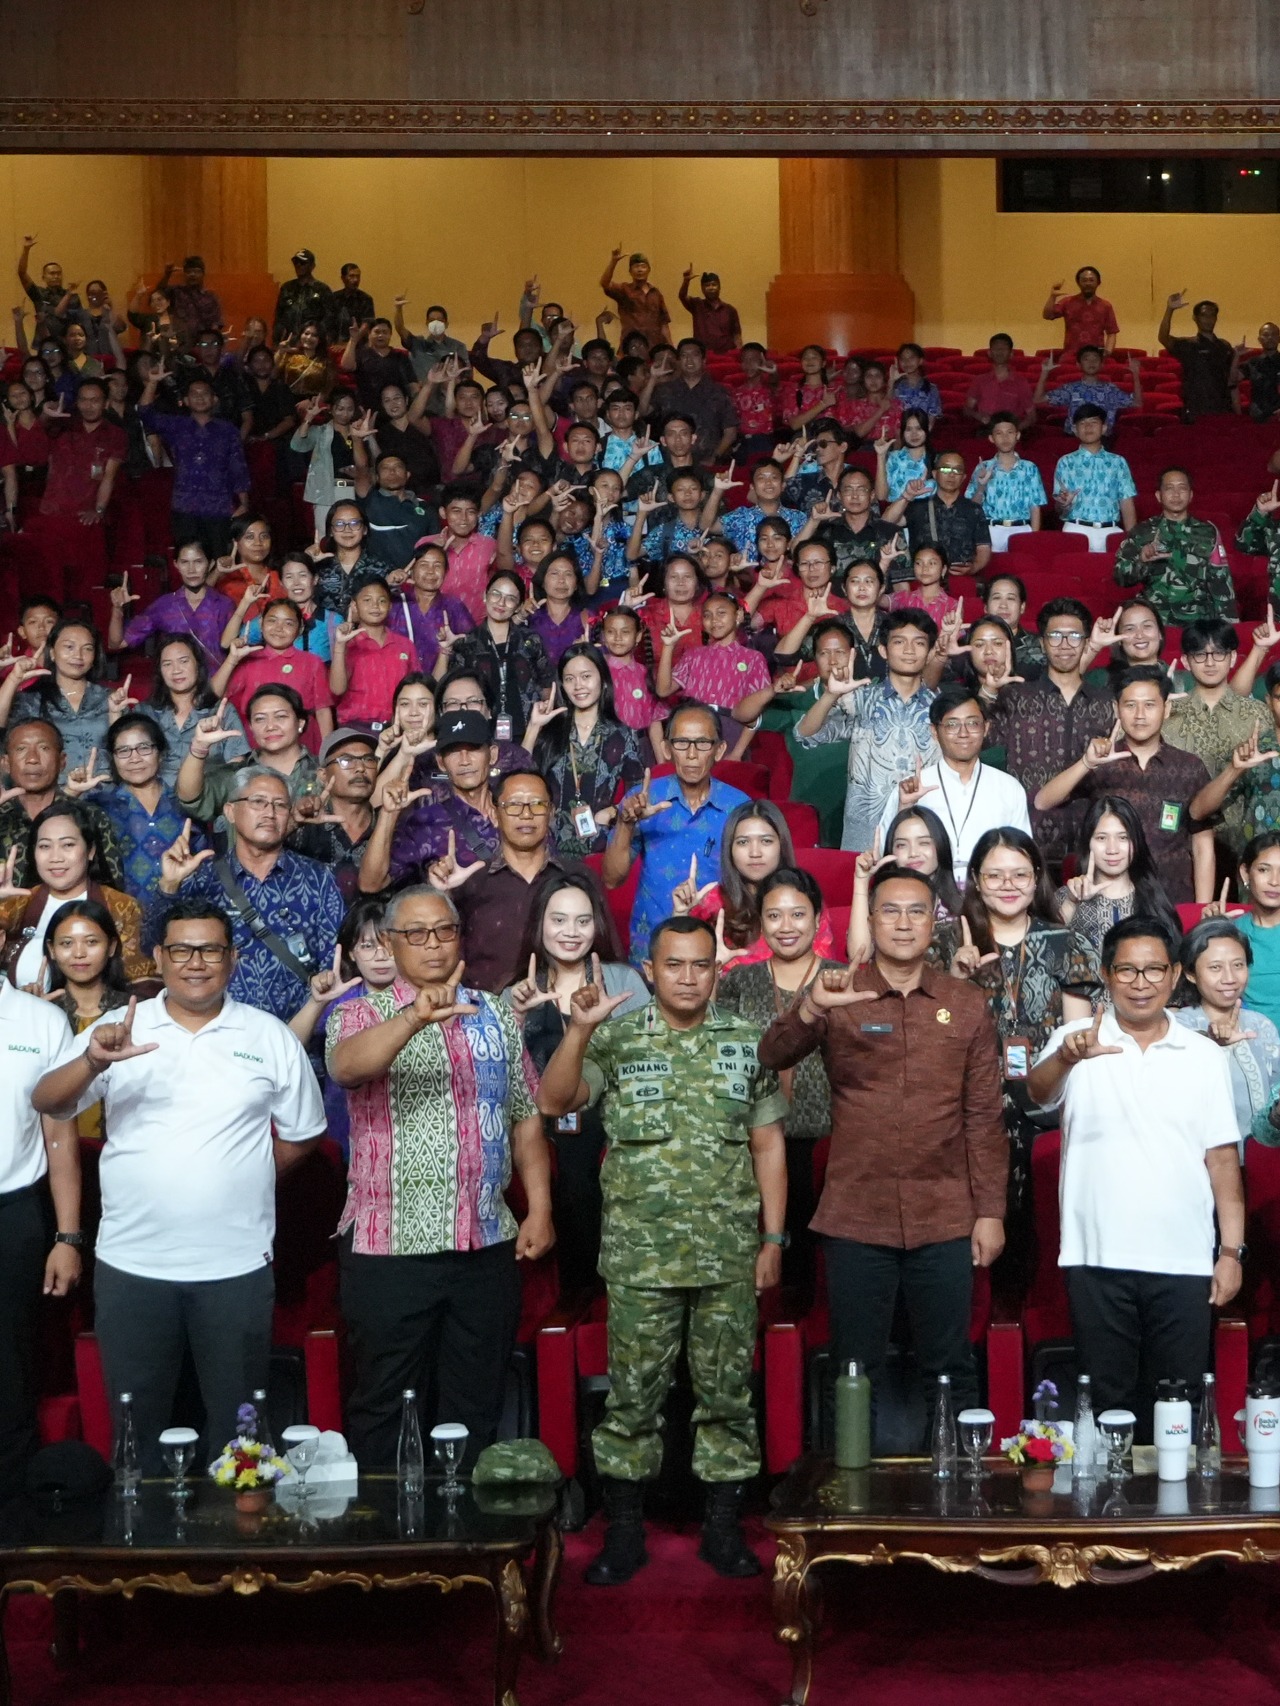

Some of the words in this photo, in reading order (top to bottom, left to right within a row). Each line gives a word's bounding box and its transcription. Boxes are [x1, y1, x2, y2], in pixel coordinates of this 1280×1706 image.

[8, 1044, 40, 1054] BADUNG
[233, 1050, 264, 1064] BADUNG
[622, 1063, 668, 1075] KOMANG
[717, 1062, 737, 1071] TNI
